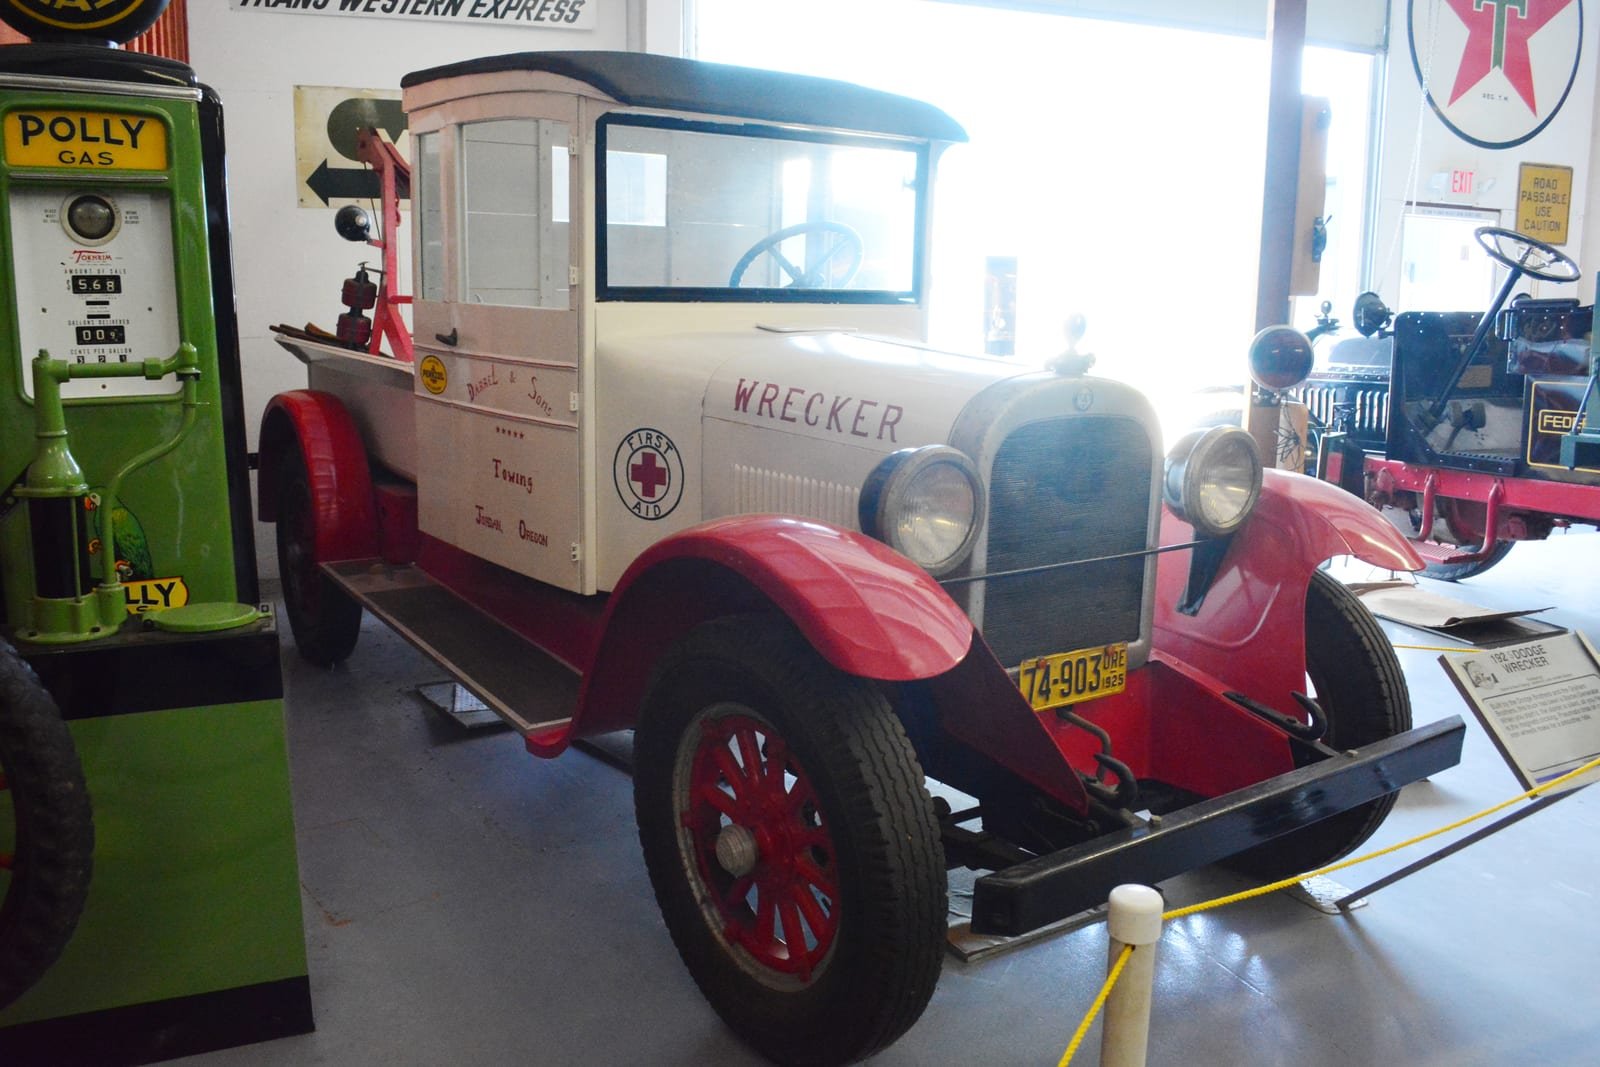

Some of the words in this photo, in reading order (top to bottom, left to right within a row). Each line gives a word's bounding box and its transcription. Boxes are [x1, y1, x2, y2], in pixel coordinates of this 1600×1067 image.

[467, 0, 586, 23] EXPRESS
[18, 114, 146, 149] POLLY
[58, 150, 114, 165] GAS
[1452, 170, 1474, 194] EXIT
[1533, 177, 1558, 190] ROAD
[1521, 191, 1567, 205] PASSABLE
[1535, 206, 1552, 217] USE
[1524, 219, 1560, 232] CAUTION
[528, 376, 553, 416] Sons
[733, 378, 904, 443] WRECKER
[626, 431, 674, 455] FIRST
[492, 458, 533, 494] Towing
[632, 501, 661, 517] AID
[125, 582, 176, 607] LLY
[1512, 644, 1547, 659] DODGE
[1502, 656, 1549, 673] WRECKER
[1023, 654, 1103, 703] 74-903
[1102, 673, 1124, 689] 1925
